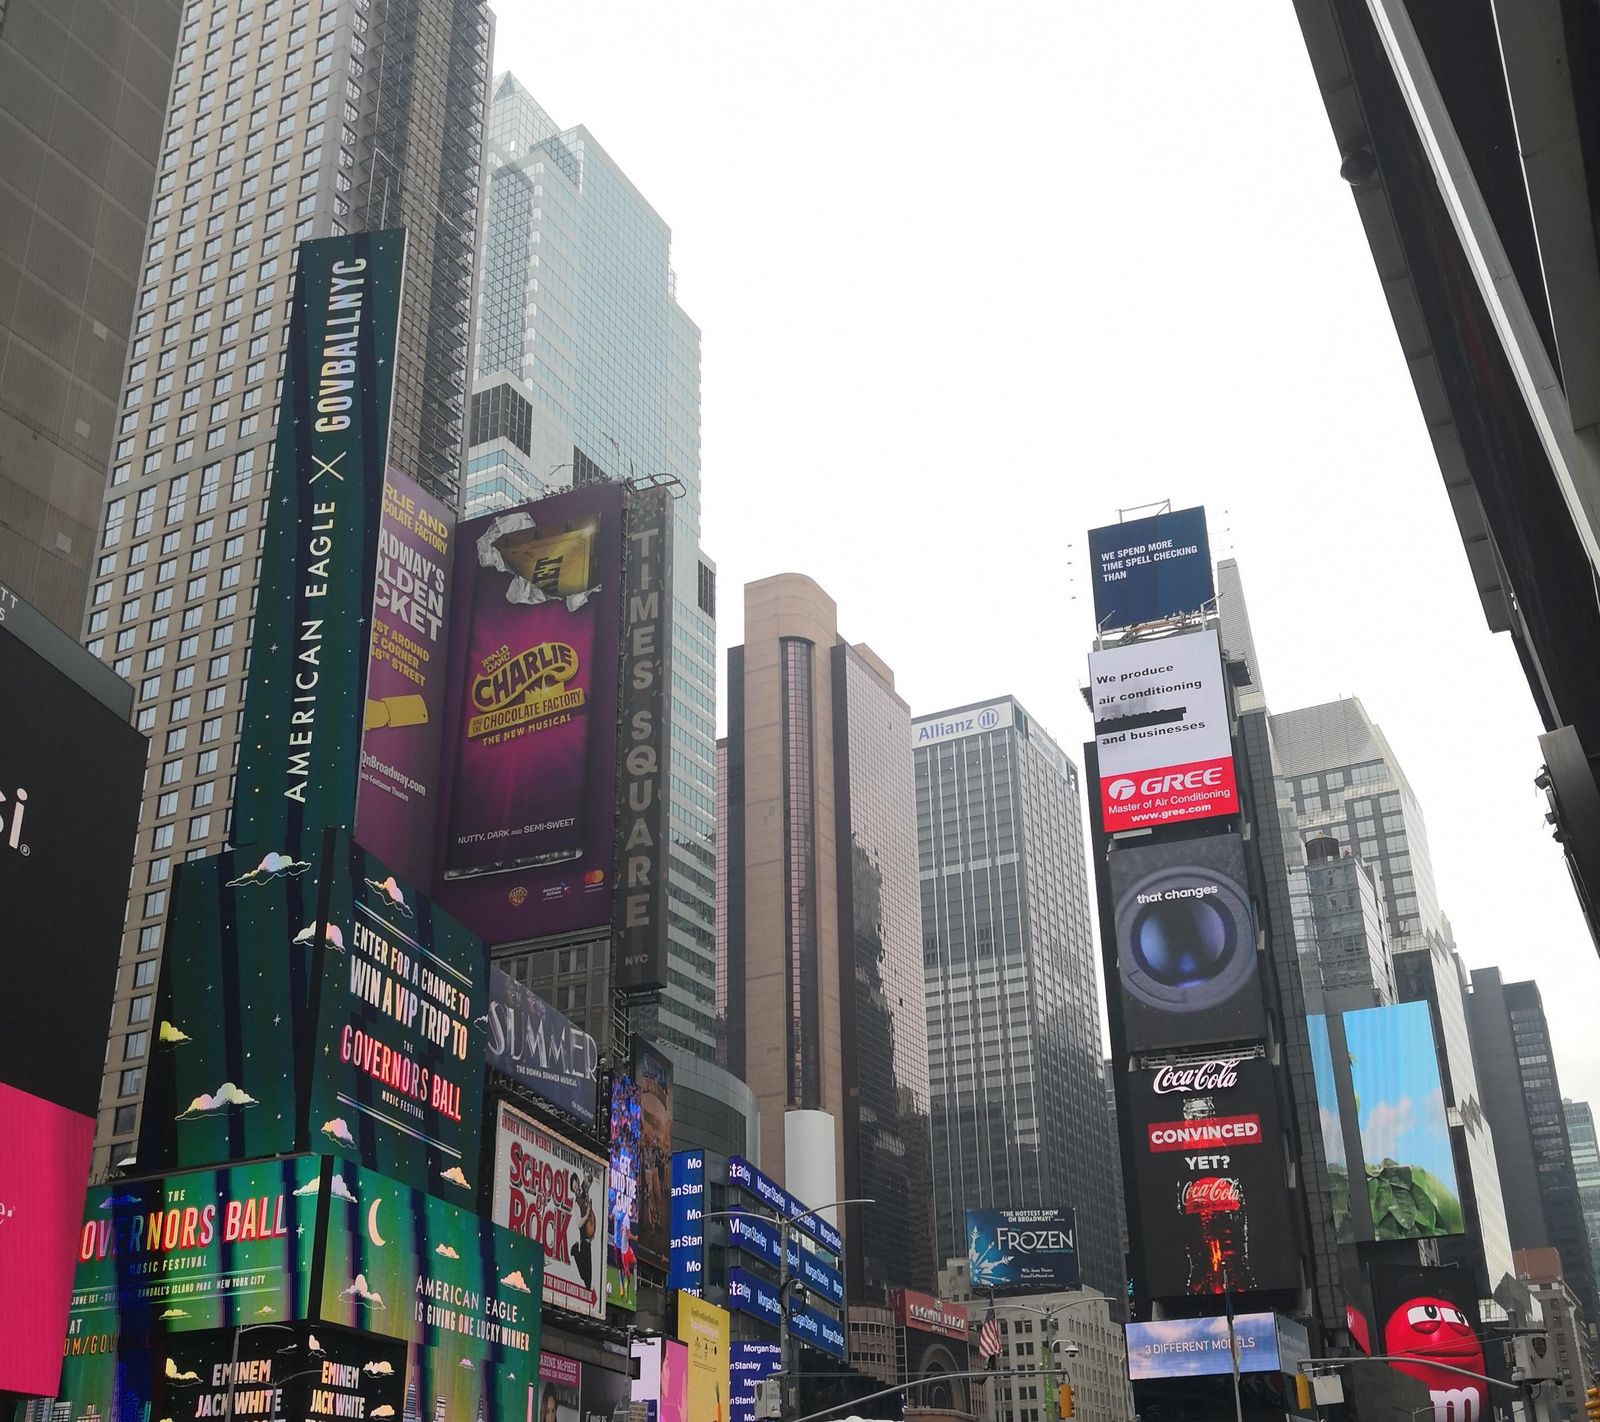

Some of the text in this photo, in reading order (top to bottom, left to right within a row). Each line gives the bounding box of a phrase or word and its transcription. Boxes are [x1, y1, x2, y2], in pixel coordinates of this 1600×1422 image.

[314, 257, 367, 433] GOVBALLNYC
[414, 520, 448, 556] FACTORY
[418, 509, 449, 539] AND
[304, 501, 336, 598] EAGLE
[1101, 540, 1173, 562] WE SPEND MORE
[1102, 545, 1198, 572] TIME SPELL CHECKING
[1103, 571, 1127, 582] THAN
[381, 636, 420, 669] CORNER
[391, 629, 430, 662] AROUND
[391, 658, 427, 687] STREET
[473, 644, 572, 707] CHARLIE
[1096, 664, 1174, 685] We produce
[1099, 679, 1202, 705] air conditioning
[283, 618, 324, 803] AMERICAN
[483, 691, 582, 730] CHOCOLATE FACTORY
[482, 713, 572, 747] THE NEW MUSICAL
[625, 528, 660, 930] TIMES SQUARE
[919, 718, 974, 741] Allianz
[1102, 720, 1206, 745] and businesses
[1140, 767, 1223, 795] GREE
[1108, 788, 1230, 814] Master of Air Conditioning
[1131, 804, 1211, 822] www.gree.com
[487, 829, 510, 840] DARK
[523, 817, 576, 834] SEMI-SWEET
[1136, 884, 1218, 904] that changes
[353, 921, 470, 1020] ENTER FOR A CHANCE TO
[624, 951, 649, 967] NYC
[350, 954, 468, 1061] WIN A VIP TRIP TO
[403, 1040, 414, 1053] THE
[340, 1024, 462, 1124] GOVERNORS BALL
[381, 1089, 425, 1121] MUSIC FESTIVAL
[1151, 1122, 1258, 1144] CONVINCED
[509, 1141, 574, 1209] SCHOOL
[1184, 1155, 1231, 1170] YET?
[168, 1189, 186, 1202] THE
[757, 1175, 786, 1211] Morgan Stanley
[222, 1194, 288, 1244] BALL
[508, 1186, 572, 1265] ROCK
[997, 1228, 1074, 1254] FROZEN
[162, 1255, 208, 1272] FESTIVAL
[171, 1281, 194, 1294] ISLAND
[195, 1281, 212, 1291] PARK
[216, 1275, 266, 1289] NEW YORK CITY
[415, 1274, 518, 1323] AMERICAN EAGLE
[757, 1289, 773, 1312] Morgan
[414, 1301, 529, 1351] IS GIVING ONE LUCKY WINNER
[743, 1344, 769, 1354] Morgan
[1144, 1339, 1208, 1355] 3 DIFFERENT
[212, 1359, 272, 1386] EMINEM
[321, 1360, 360, 1389] EMINEM
[735, 1361, 761, 1372] Stanley
[234, 1388, 283, 1416] WHITE
[310, 1389, 366, 1419] JACK WHITE
